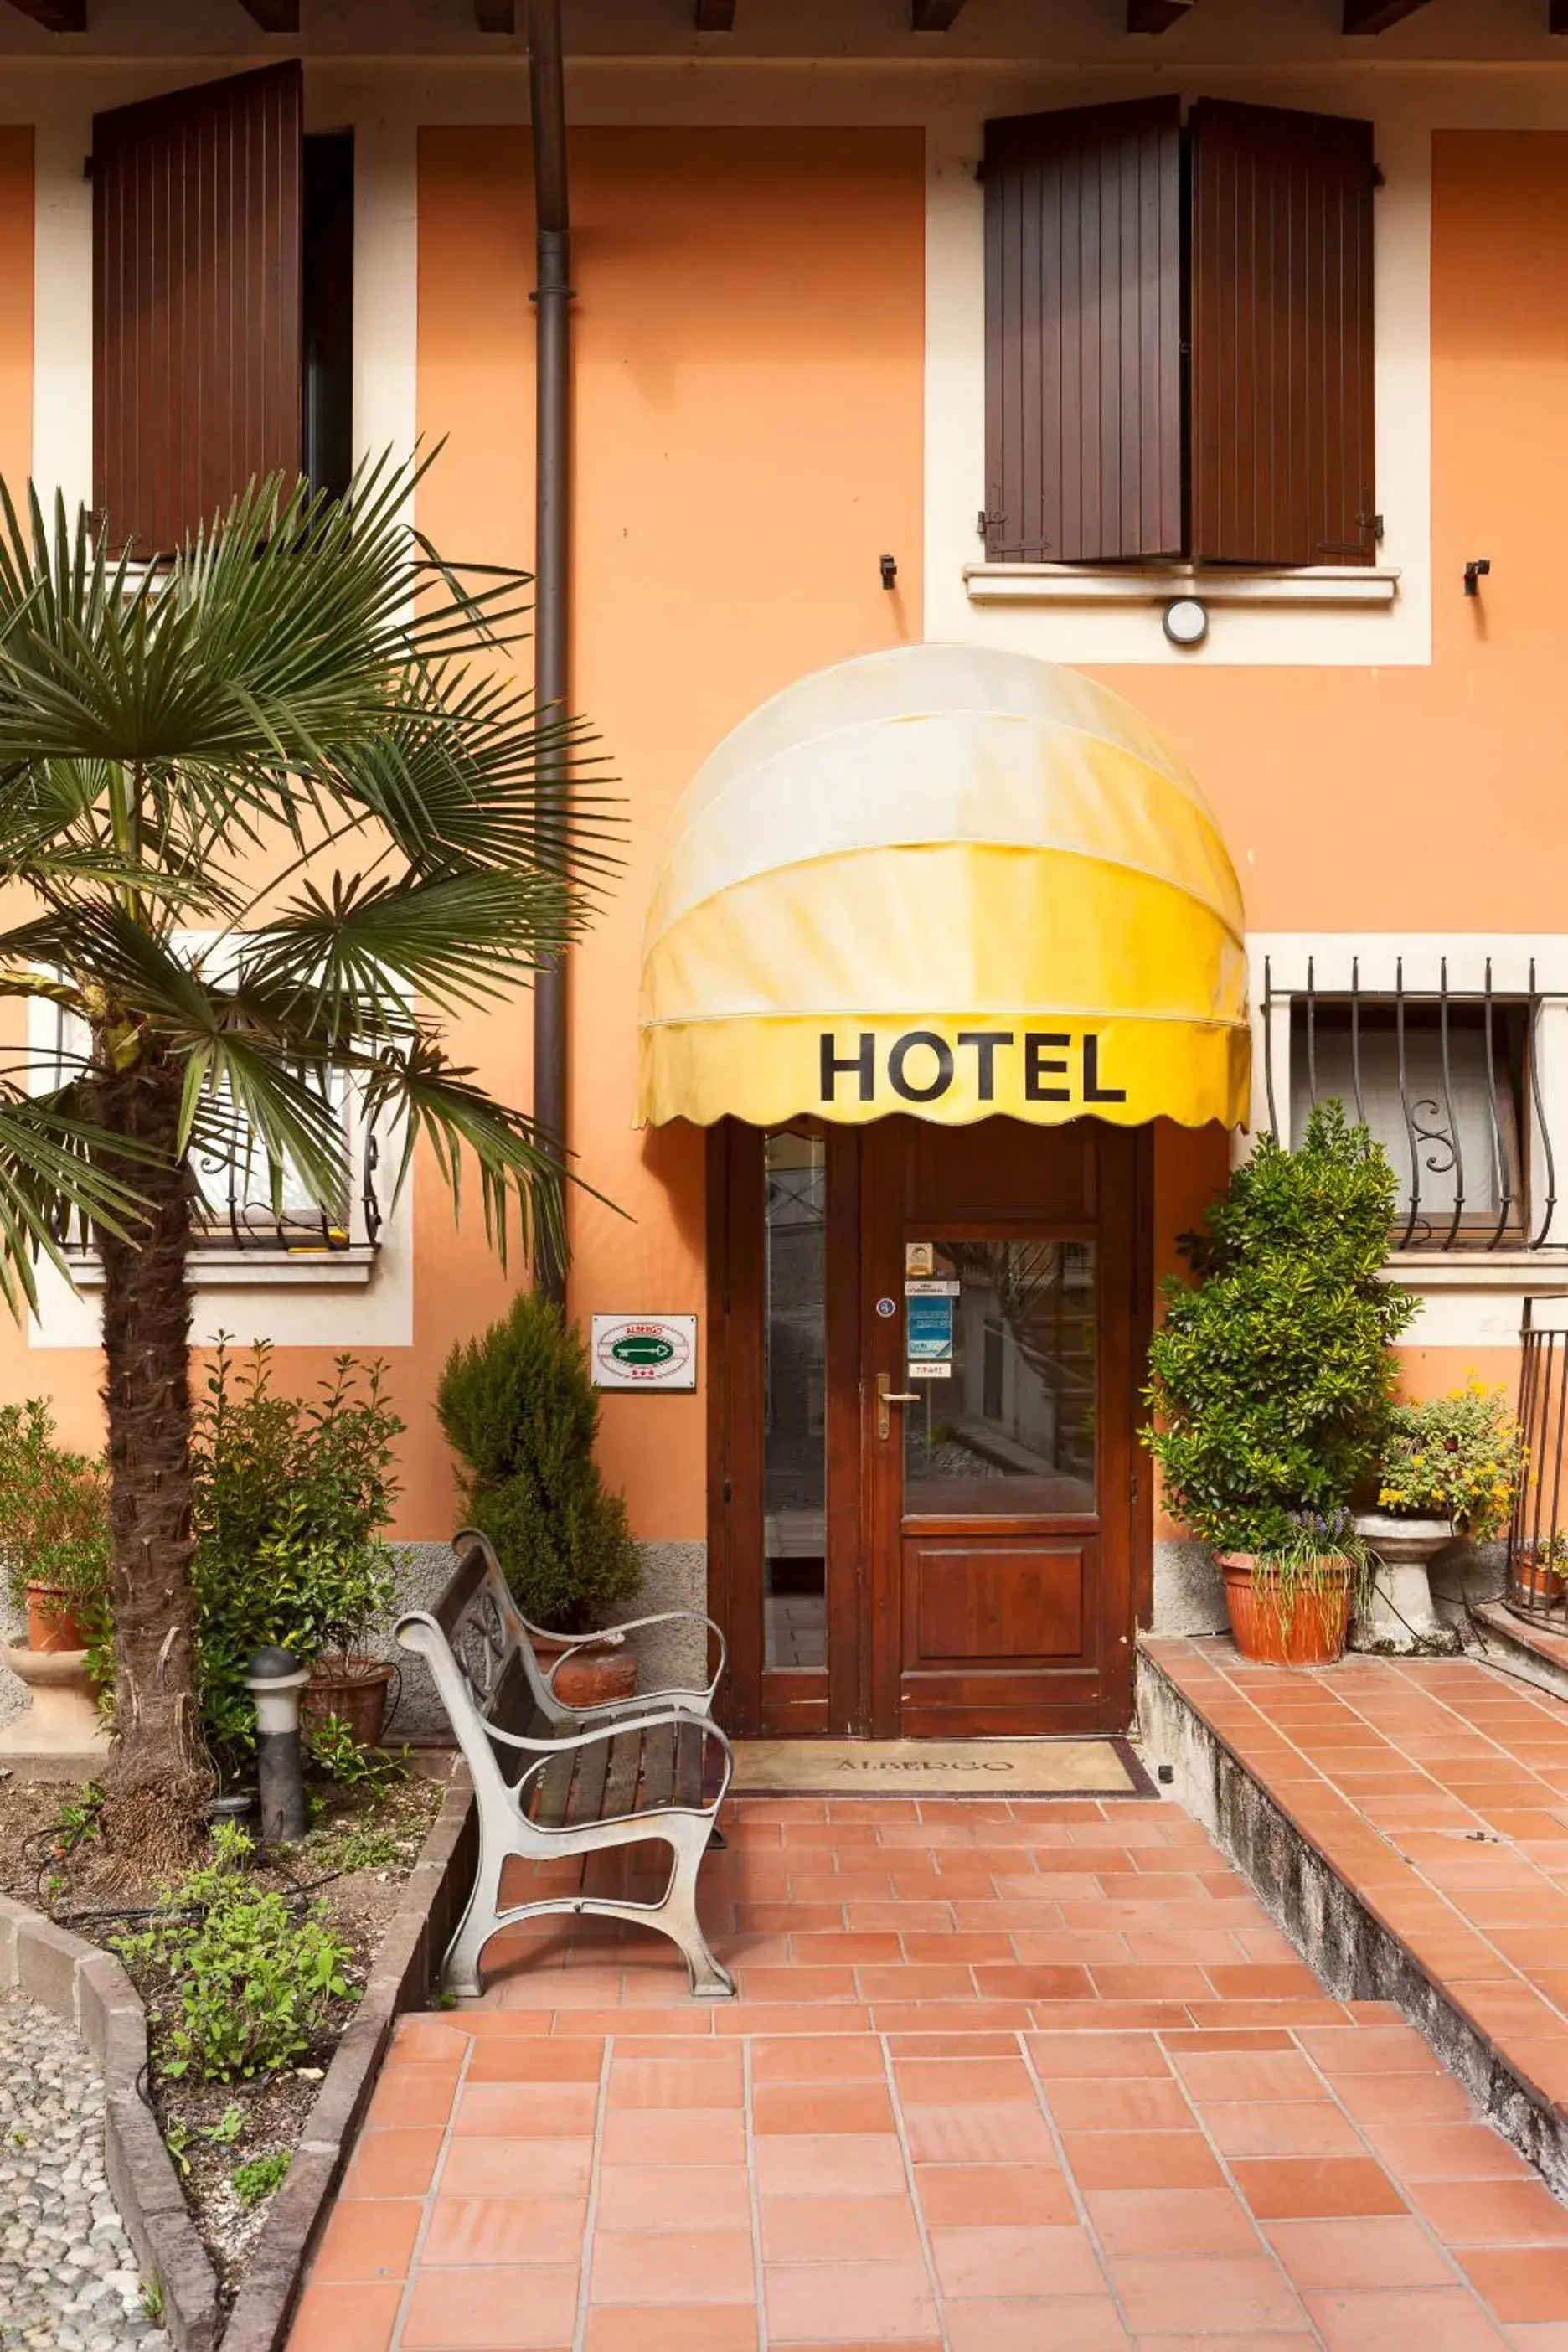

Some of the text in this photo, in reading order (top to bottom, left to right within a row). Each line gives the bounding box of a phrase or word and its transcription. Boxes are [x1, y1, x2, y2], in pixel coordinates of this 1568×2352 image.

[820, 1031, 1127, 1102] HOTEL
[626, 1325, 663, 1334] ALBERGO
[837, 1758, 1015, 1772] ALBERGO
